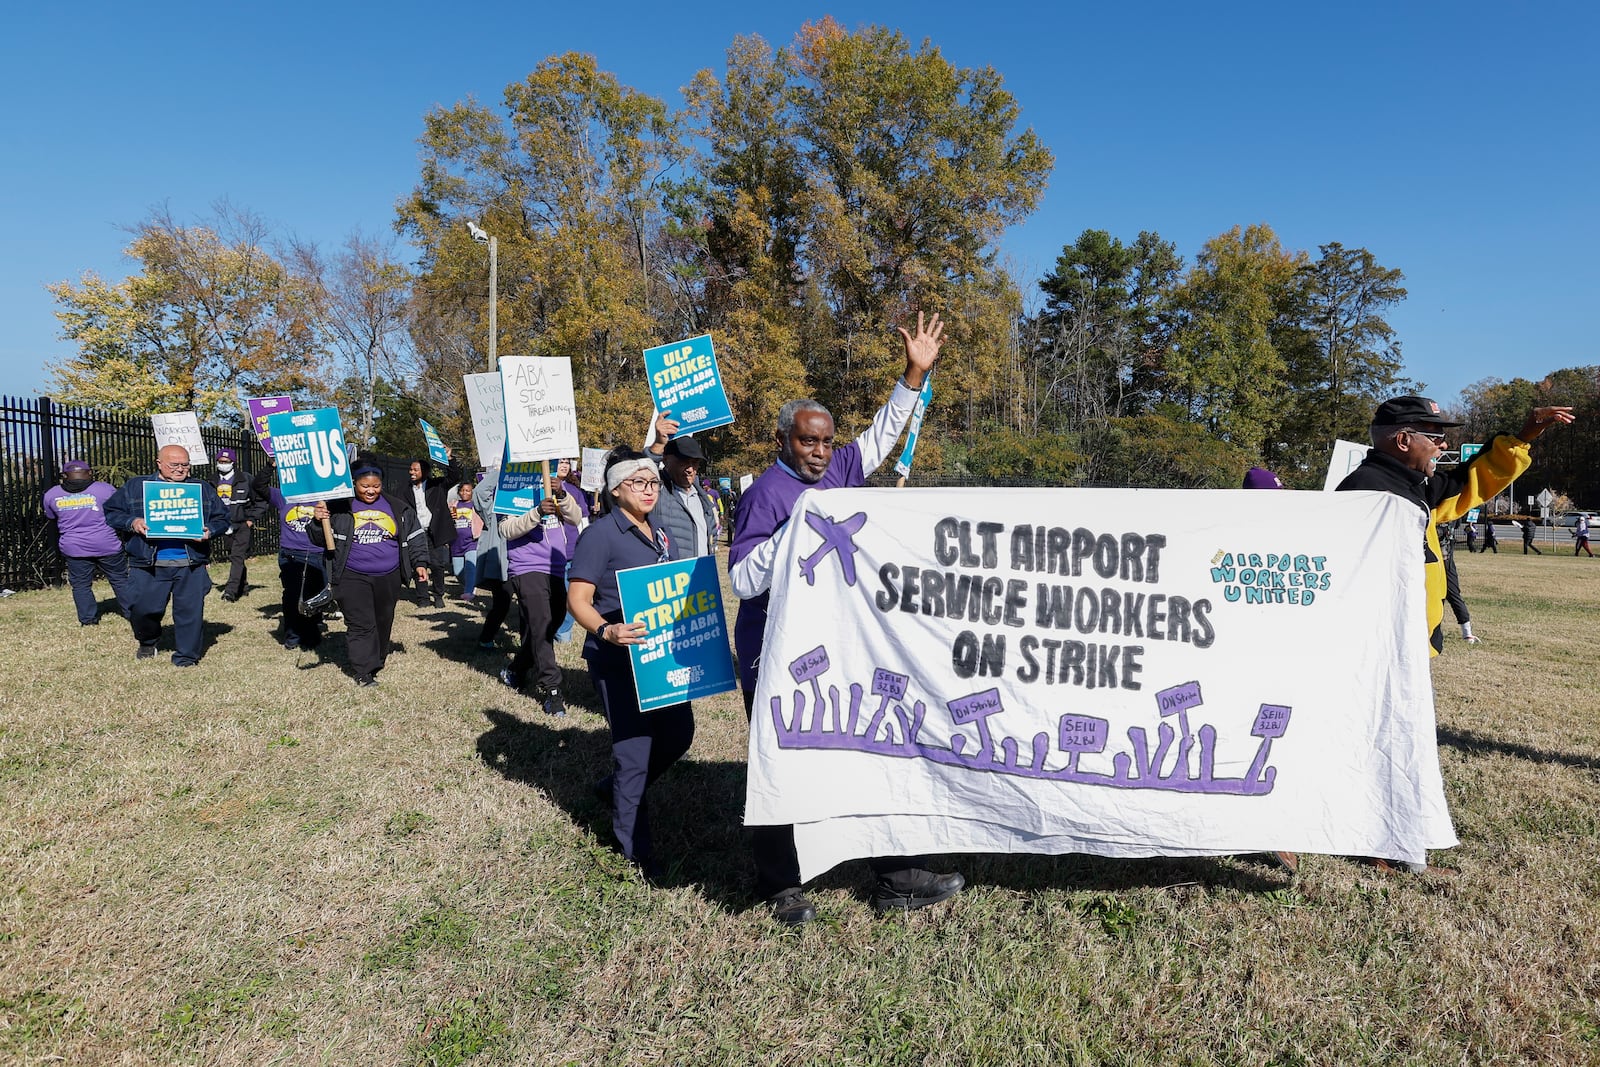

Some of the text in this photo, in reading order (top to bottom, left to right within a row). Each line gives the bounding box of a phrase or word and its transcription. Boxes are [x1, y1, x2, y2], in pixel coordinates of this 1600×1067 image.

[663, 345, 693, 367] ULP
[653, 354, 712, 388] STRIKE:
[658, 367, 714, 400] Against ABM
[660, 377, 716, 408] and Prospect
[519, 388, 546, 404] STOP
[153, 413, 187, 427] CLT
[155, 425, 198, 435] WORKERS
[168, 435, 187, 444] ON
[272, 432, 306, 451] RESPECT
[276, 448, 310, 468] PROTECT
[307, 428, 347, 478] US
[280, 467, 297, 484] PAY
[504, 462, 555, 473] STRIK:
[503, 474, 534, 483] Against
[519, 482, 546, 491] Prosp
[159, 488, 185, 498] ULP
[148, 498, 199, 510] STRIKE:
[934, 516, 1166, 583] CLT AIRPORT
[1221, 552, 1327, 572] AIRPORT
[647, 572, 690, 603] ULP
[1210, 566, 1332, 591] WORKERS
[1224, 584, 1315, 606] UNITED
[633, 590, 717, 632] STRIKE:
[875, 562, 1216, 649] SERVICE WORKERS
[638, 612, 719, 651] Against ABM
[640, 626, 721, 665] and Prospect
[952, 630, 1144, 690] ON STRIKE
[1261, 709, 1285, 720] SEIU
[1065, 719, 1096, 732] SEIU
[1066, 735, 1095, 746] 32BJ
